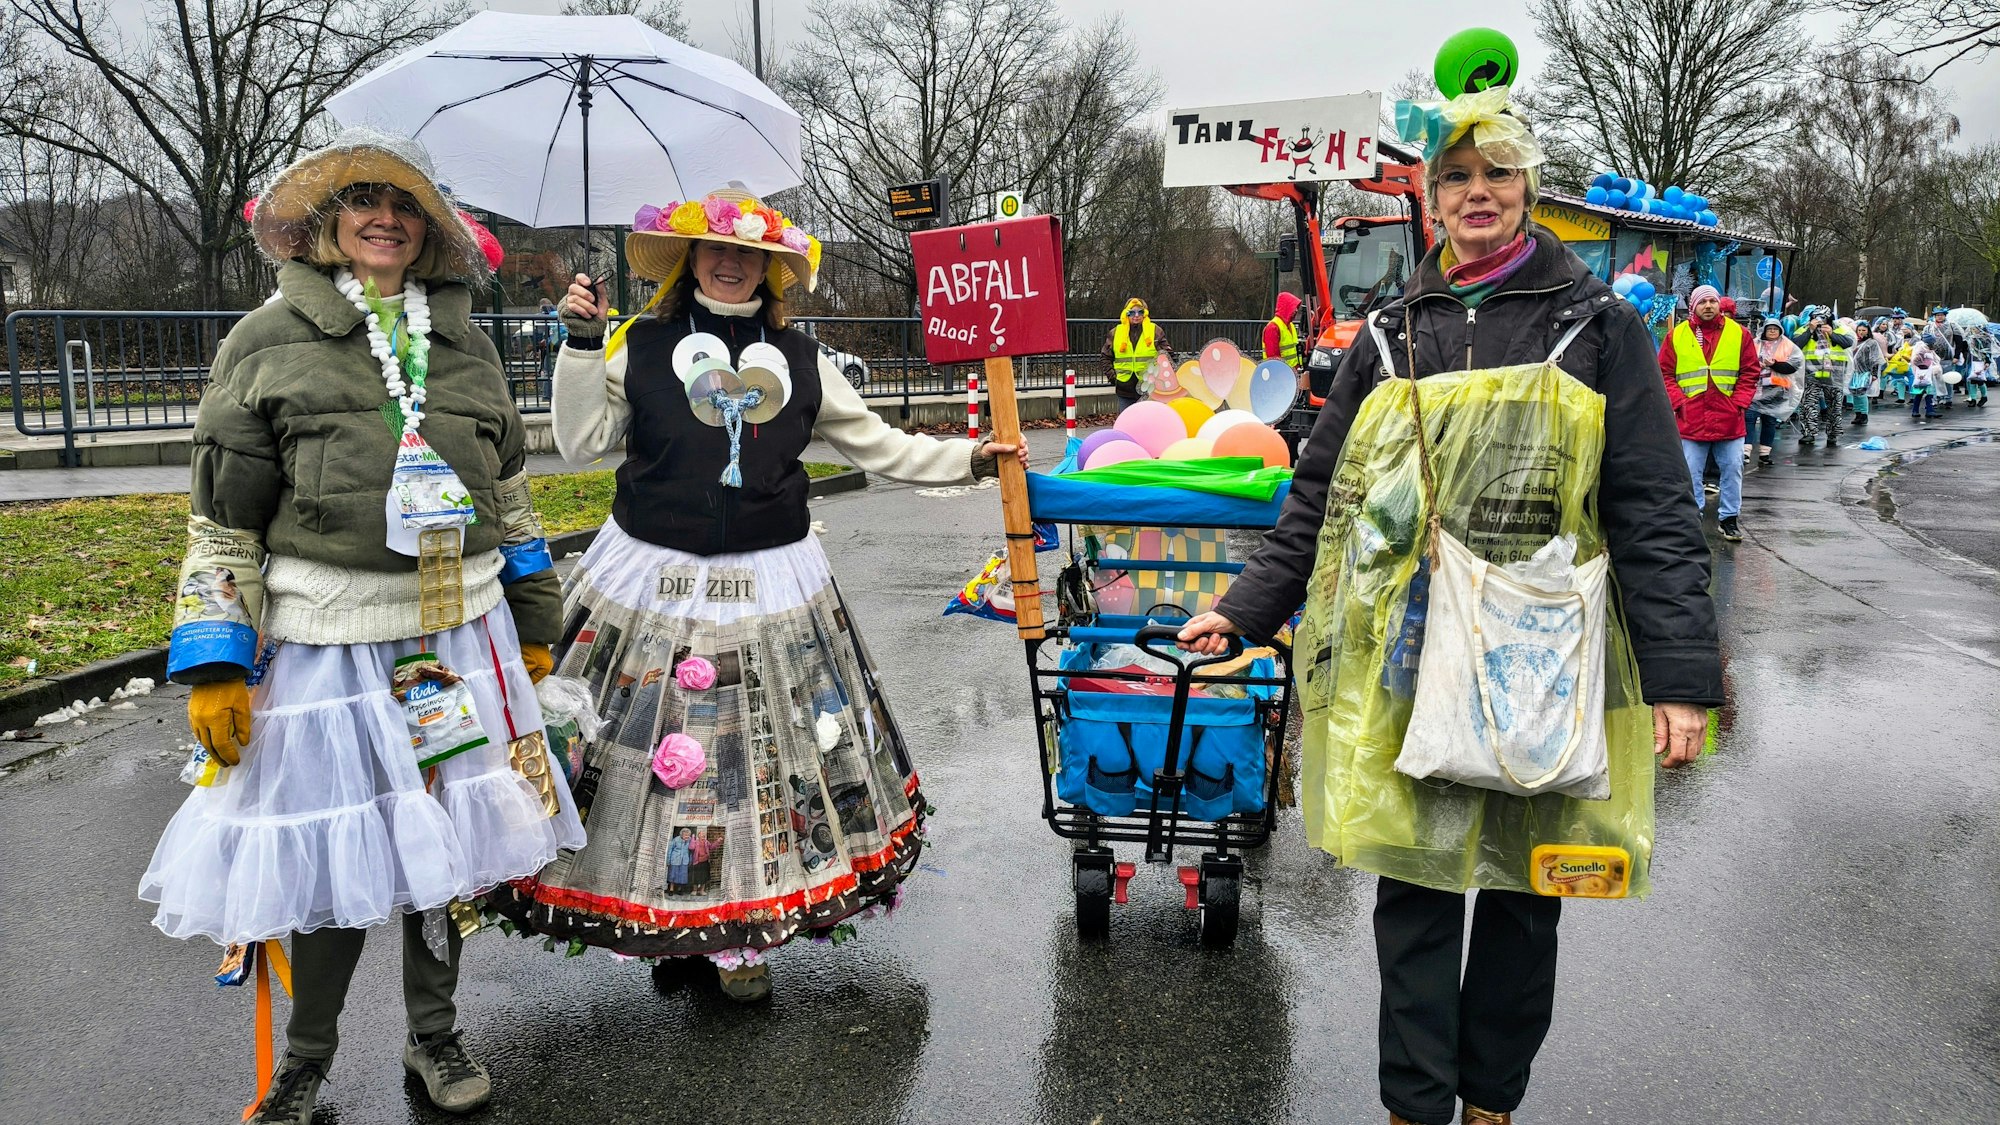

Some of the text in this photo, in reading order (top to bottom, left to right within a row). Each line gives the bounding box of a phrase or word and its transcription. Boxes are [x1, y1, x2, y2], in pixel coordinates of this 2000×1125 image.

[1172, 114, 1254, 145] TANZ
[1541, 206, 1608, 238] DONRATH
[927, 256, 1039, 307] ABFALL
[989, 303, 1006, 346] ?
[1520, 443, 1535, 451] Sack
[1339, 473, 1362, 488] Sack
[1501, 482, 1520, 495] Der
[659, 577, 752, 597] DIE ZEIT
[410, 681, 440, 701] Puda
[1560, 861, 1606, 873] Sanella
